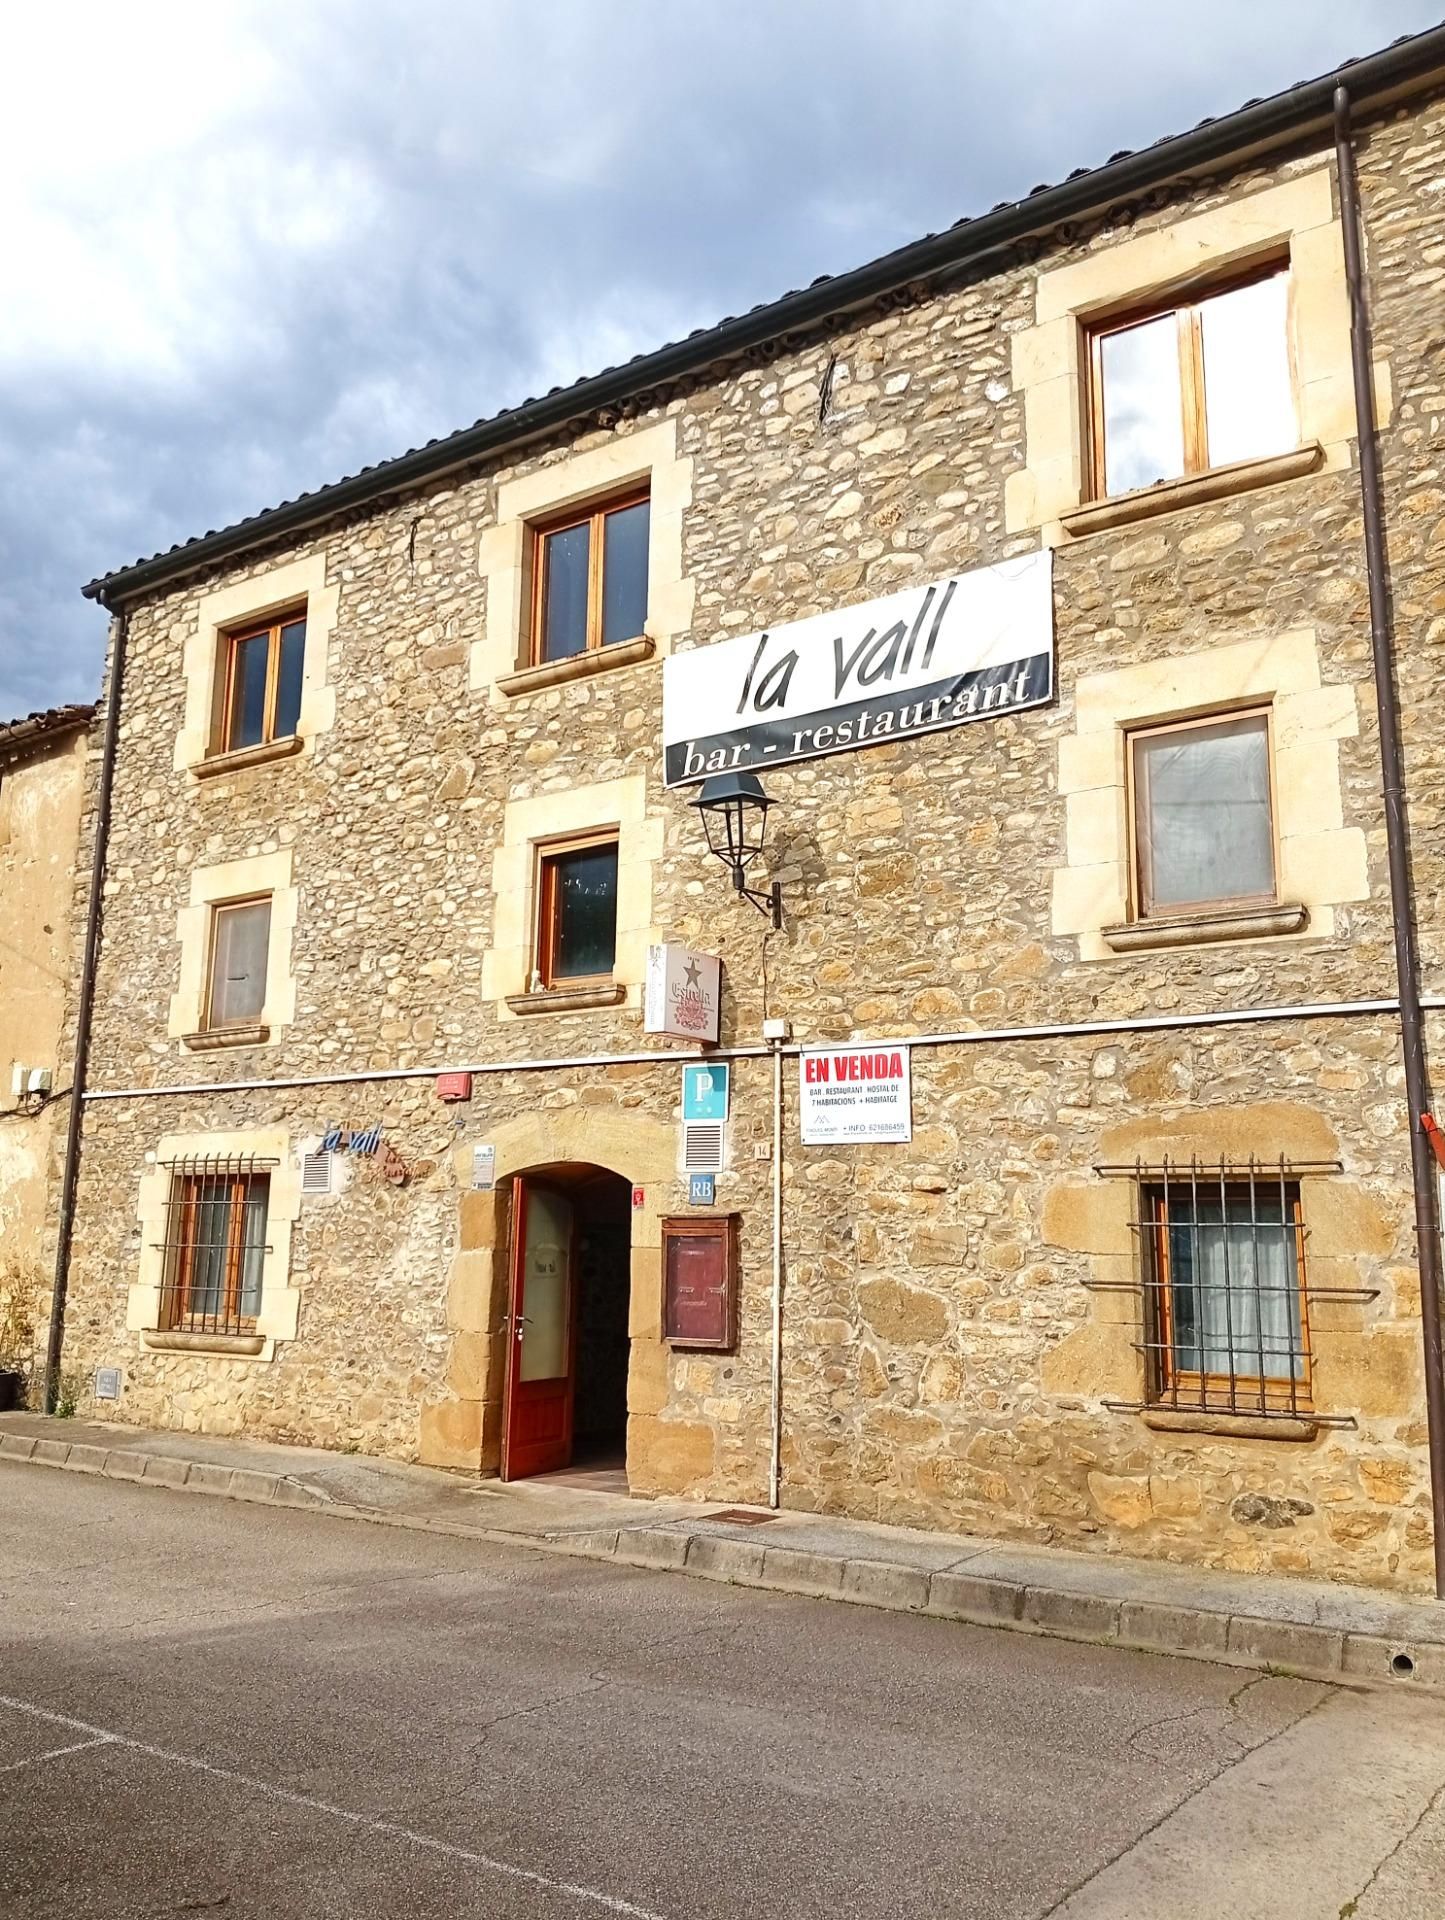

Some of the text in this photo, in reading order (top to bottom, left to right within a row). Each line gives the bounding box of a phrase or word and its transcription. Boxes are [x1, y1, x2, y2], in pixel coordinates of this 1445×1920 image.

[736, 580, 957, 714] la vall
[681, 741, 751, 777] bar
[790, 670, 1031, 755] restaurant
[805, 1052, 903, 1083] EN VENDA
[694, 1072, 714, 1102] P
[810, 1084, 899, 1096] BAR RESTAURANT HOSTAL DE
[816, 1097, 856, 1107] HABITACIONS
[865, 1095, 898, 1104] HABITATGE
[349, 1116, 384, 1155] vall
[848, 1124, 866, 1132] INFO
[691, 1181, 711, 1197] RB
